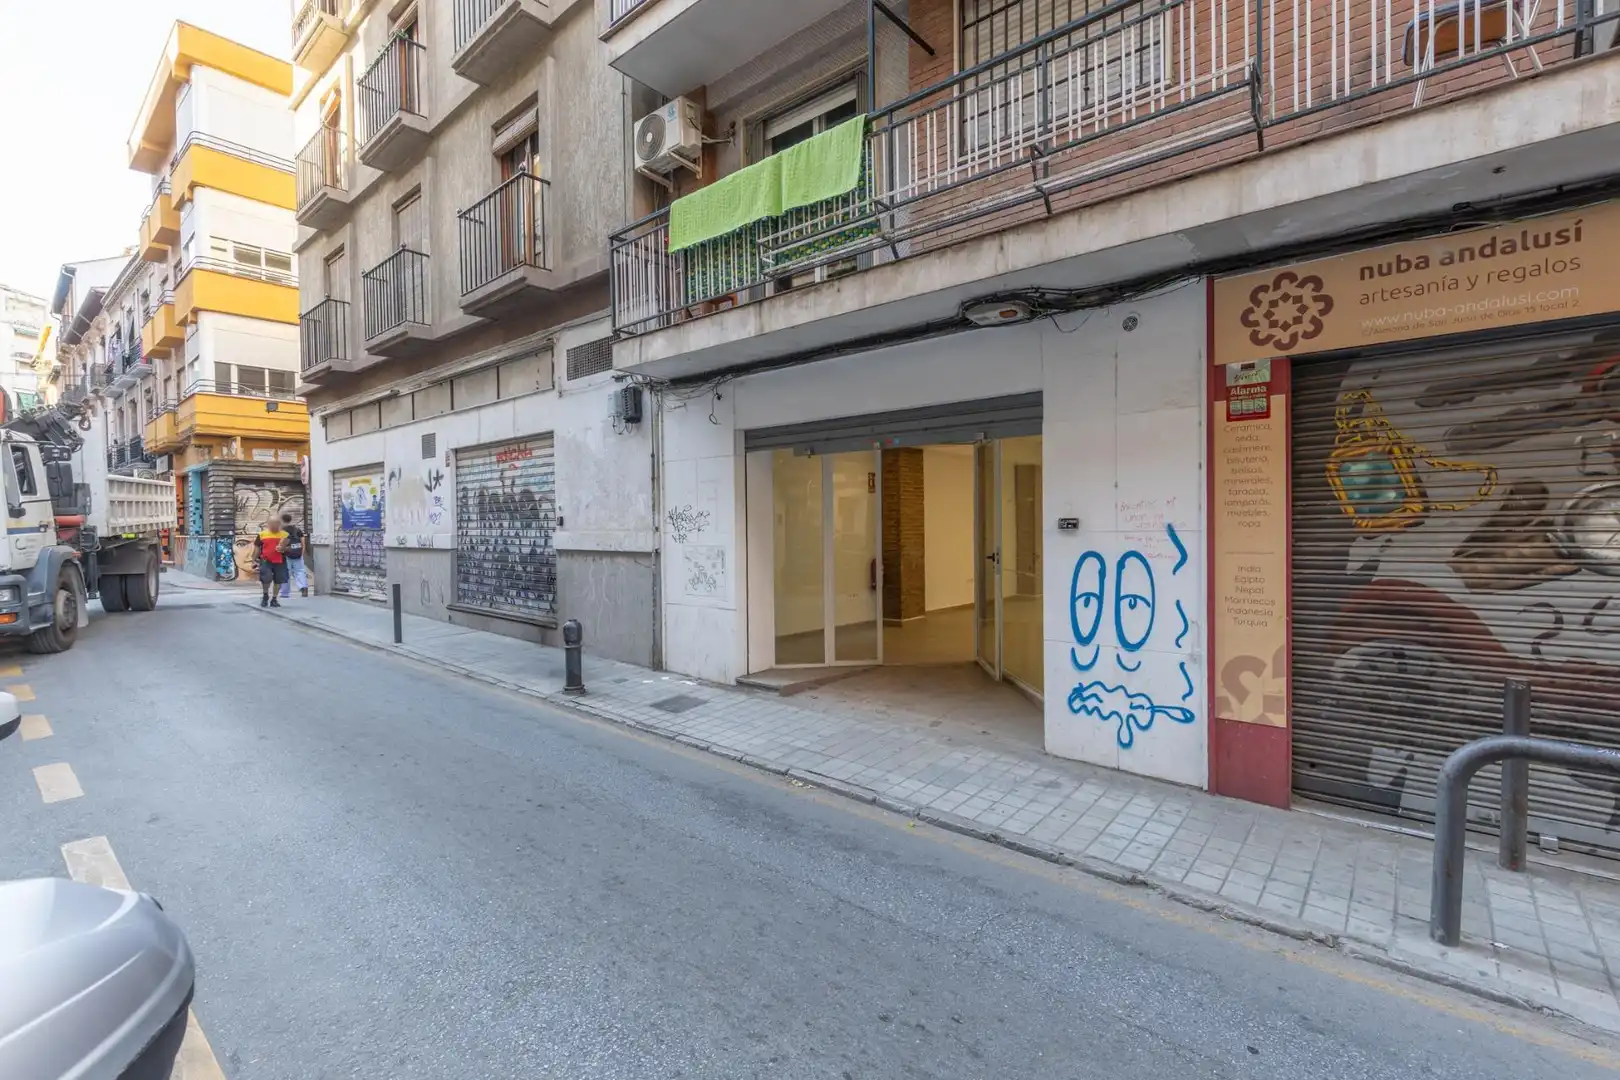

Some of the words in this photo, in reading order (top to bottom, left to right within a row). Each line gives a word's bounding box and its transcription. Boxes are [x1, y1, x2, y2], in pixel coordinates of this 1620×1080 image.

[1359, 254, 1430, 281] nuba
[1439, 219, 1583, 267] andalusí
[1359, 274, 1459, 305] artesanía
[1466, 274, 1479, 291] y
[1487, 257, 1581, 284] regalos
[1230, 385, 1267, 396] Alarma
[1237, 565, 1261, 573] India
[1235, 575, 1266, 584] Egipto
[1235, 586, 1264, 596] Nepal
[1224, 596, 1276, 606] Marruecos
[1227, 607, 1274, 617] Indonesia
